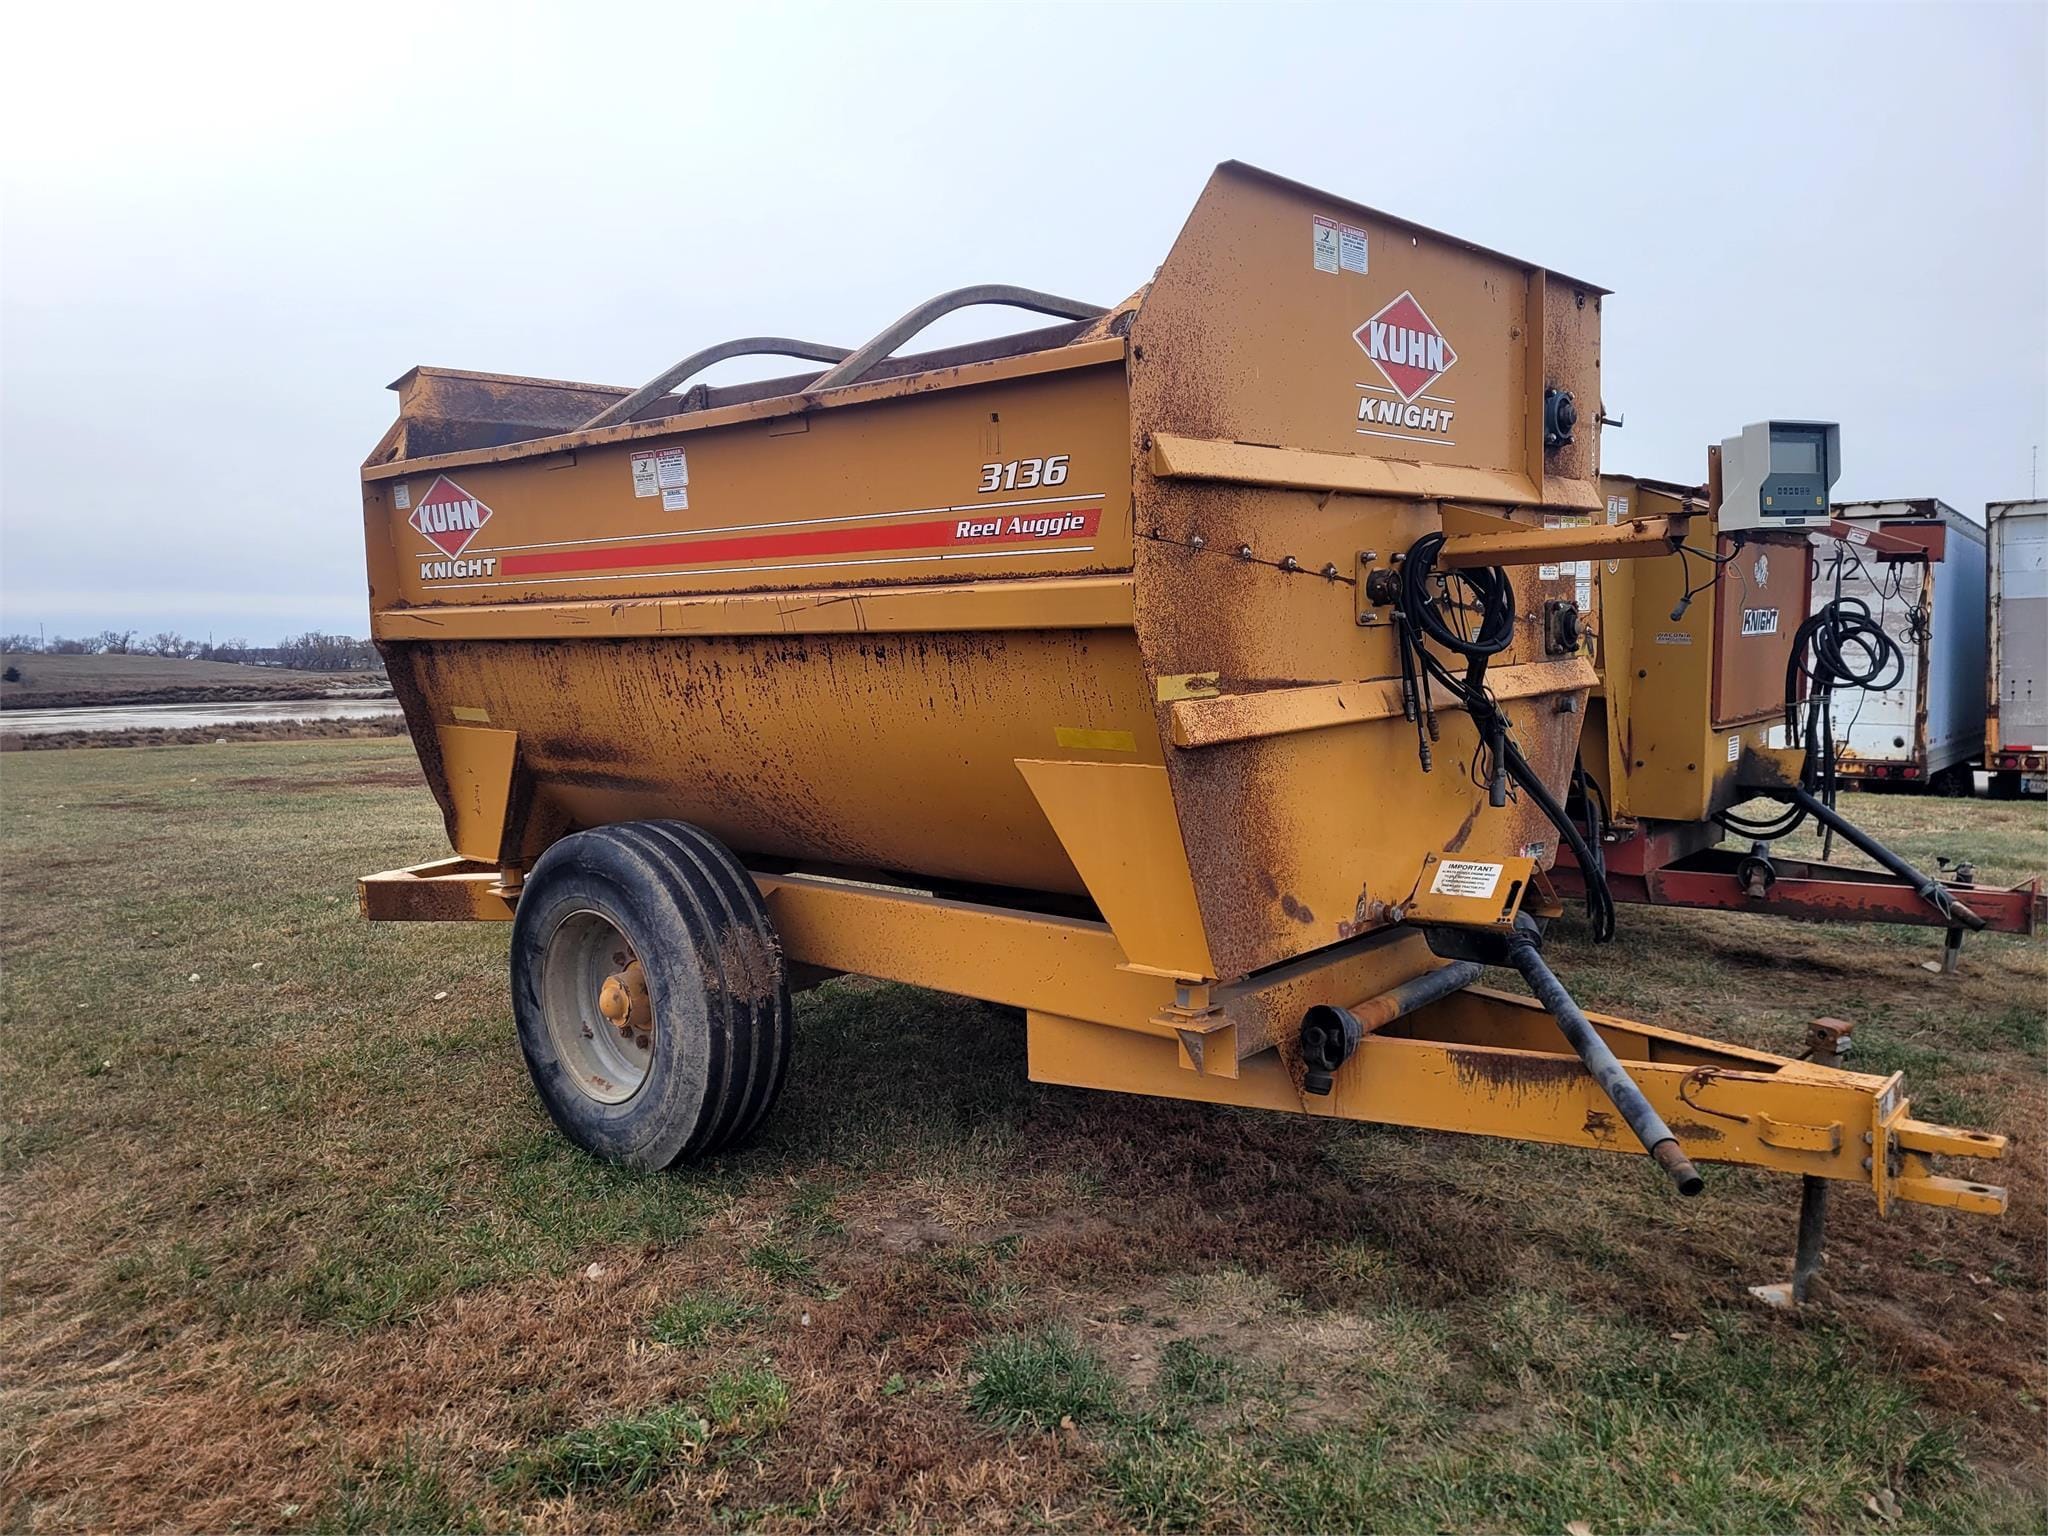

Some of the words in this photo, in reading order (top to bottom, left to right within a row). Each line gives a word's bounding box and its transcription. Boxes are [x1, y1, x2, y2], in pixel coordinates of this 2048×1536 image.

[1369, 320, 1445, 372] KUHN
[1357, 396, 1454, 434] KNIGHT
[977, 454, 1070, 493] 3136
[418, 499, 480, 534] KUHN
[955, 517, 1003, 539] Reel
[1006, 512, 1085, 536] Auggie
[420, 557, 496, 581] KNIGHT
[1743, 608, 1778, 632] KNIGHT
[1448, 863, 1494, 872] IMPORTANT
